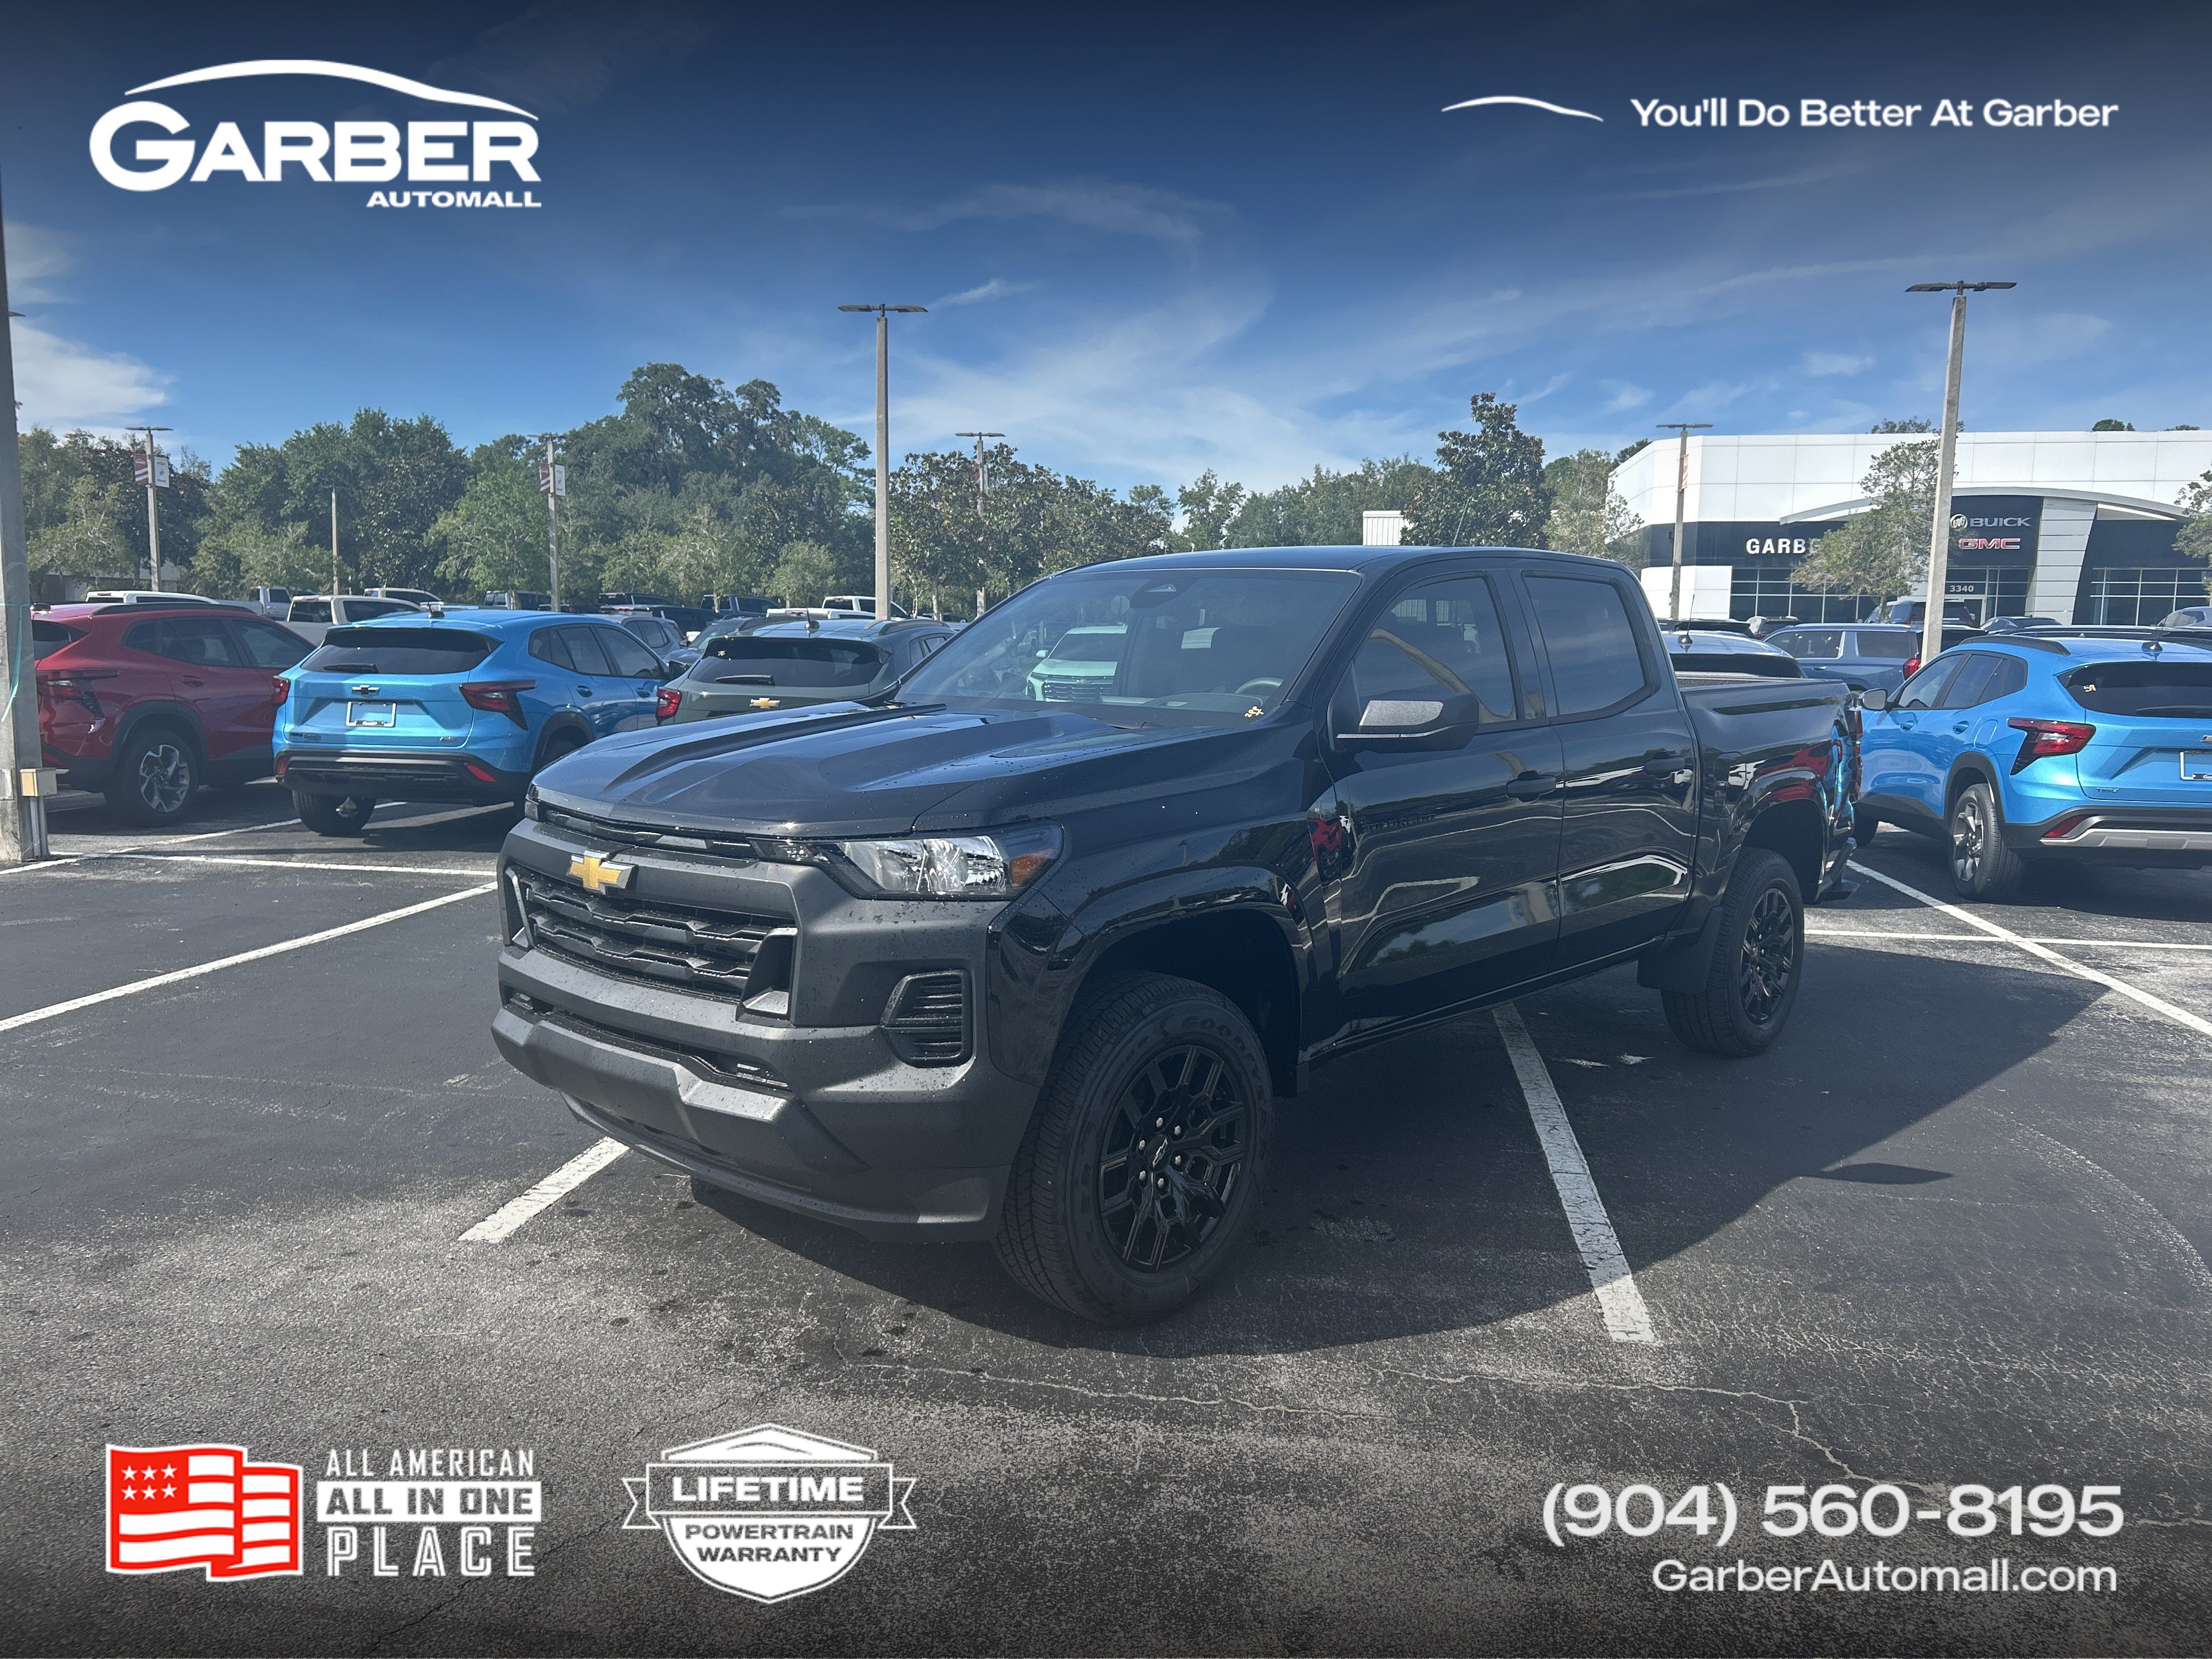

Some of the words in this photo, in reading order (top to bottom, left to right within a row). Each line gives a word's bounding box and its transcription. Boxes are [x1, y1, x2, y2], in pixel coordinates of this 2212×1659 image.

[1970, 517, 2032, 527] BUICK
[1746, 538, 1821, 554] GARBE
[1959, 538, 2021, 549] GMC
